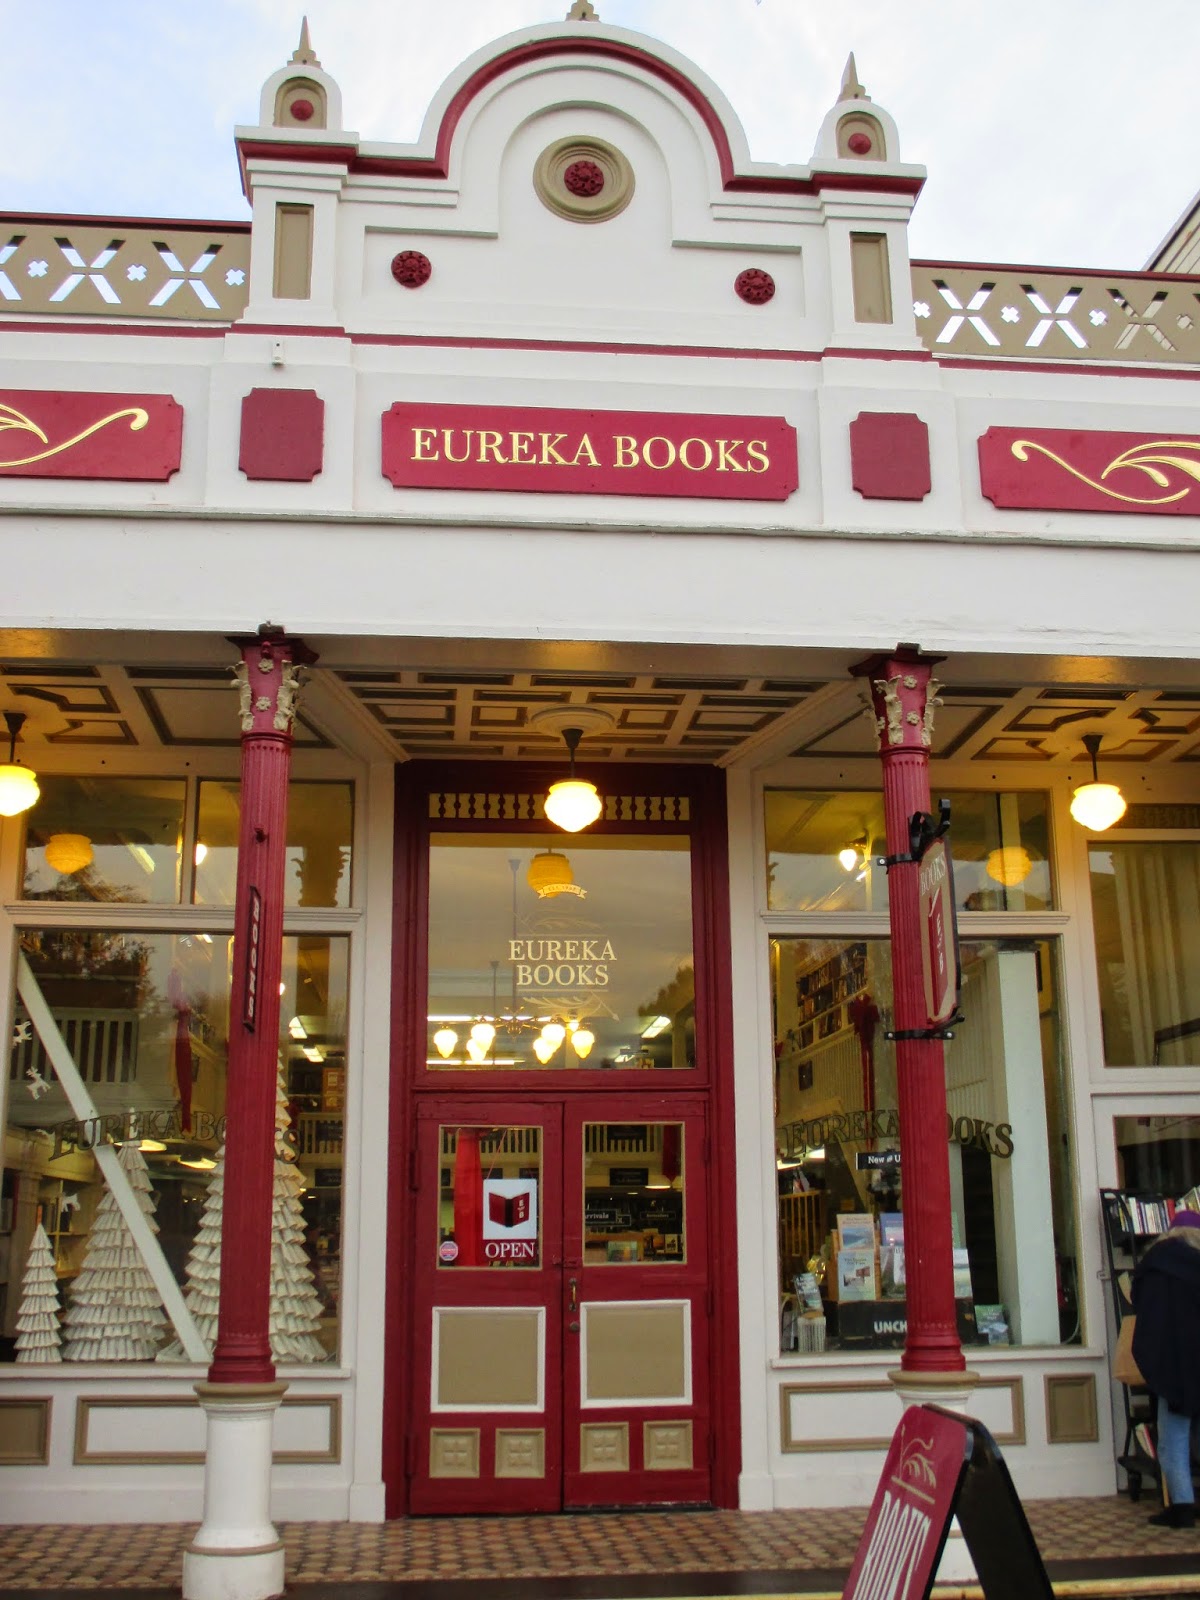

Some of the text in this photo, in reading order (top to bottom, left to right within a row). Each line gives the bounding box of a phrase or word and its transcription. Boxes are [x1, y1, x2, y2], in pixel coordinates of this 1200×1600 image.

[411, 427, 770, 473] EUREKA BOOKS
[921, 854, 946, 896] BOOKS
[508, 939, 617, 961] EUREKA
[516, 964, 609, 986] BOOKS
[49, 1109, 186, 1162] EUREKA
[777, 1109, 900, 1160] EUREKA
[585, 1211, 610, 1220] rrivals
[484, 1242, 536, 1259] OPEN
